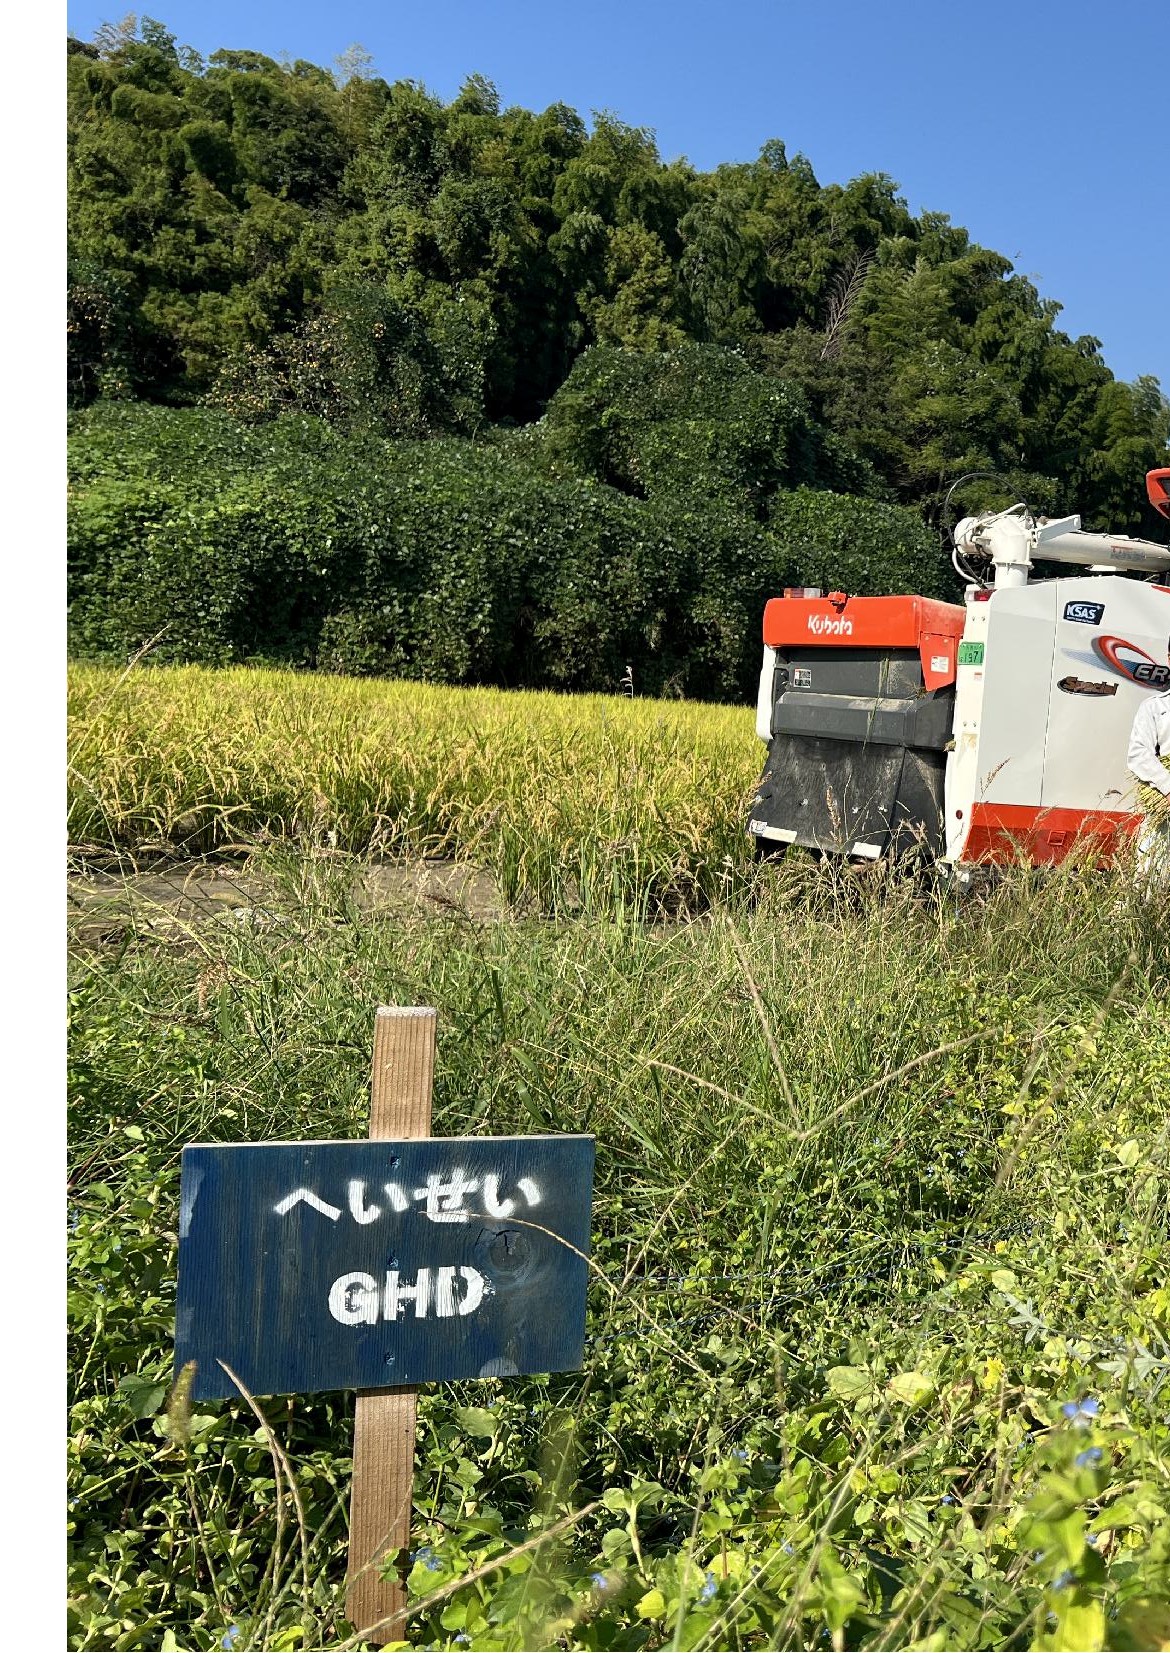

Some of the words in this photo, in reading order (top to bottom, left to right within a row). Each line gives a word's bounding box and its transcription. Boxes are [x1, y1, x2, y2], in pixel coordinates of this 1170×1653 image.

[807, 614, 853, 635] Kubota
[1066, 604, 1097, 619] KSAS
[273, 1168, 542, 1225] へいせい
[328, 1265, 490, 1327] GHD
